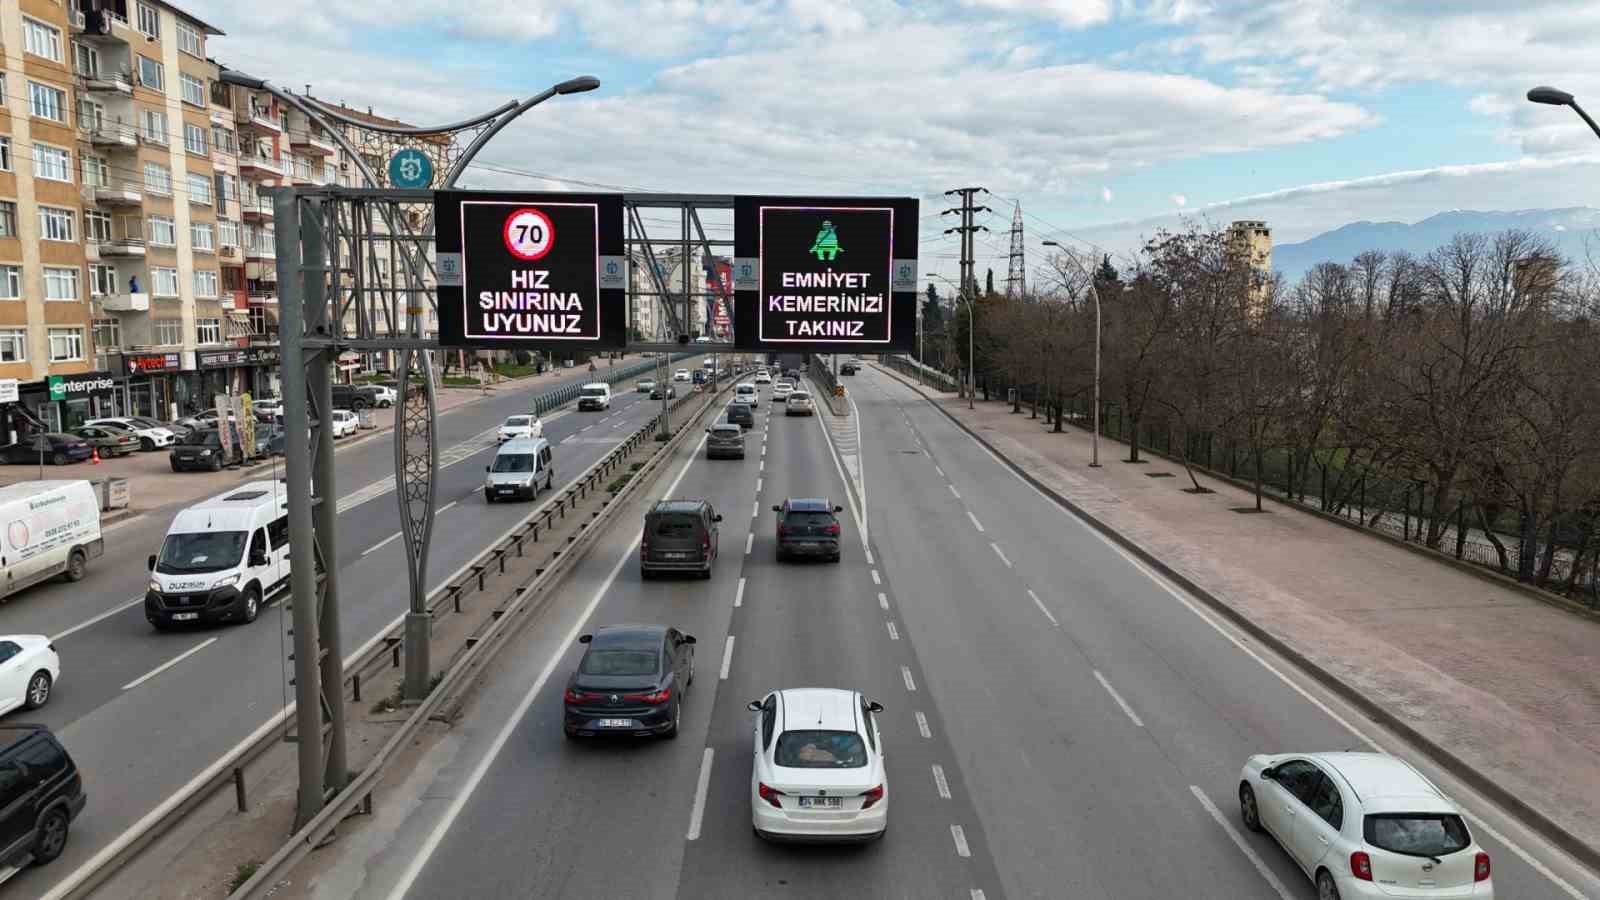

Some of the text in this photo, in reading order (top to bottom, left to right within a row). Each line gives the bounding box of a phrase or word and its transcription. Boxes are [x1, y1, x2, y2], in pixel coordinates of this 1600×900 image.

[516, 225, 543, 244] 70
[511, 270, 549, 289] HIZ
[782, 268, 871, 289] EMNİYET
[479, 291, 583, 311] SINIRINA
[769, 293, 883, 313] KEMERİNİZİ
[483, 313, 581, 333] UYUNUZ
[785, 320, 865, 337] TAKINIZ
[50, 377, 114, 394] enterprise
